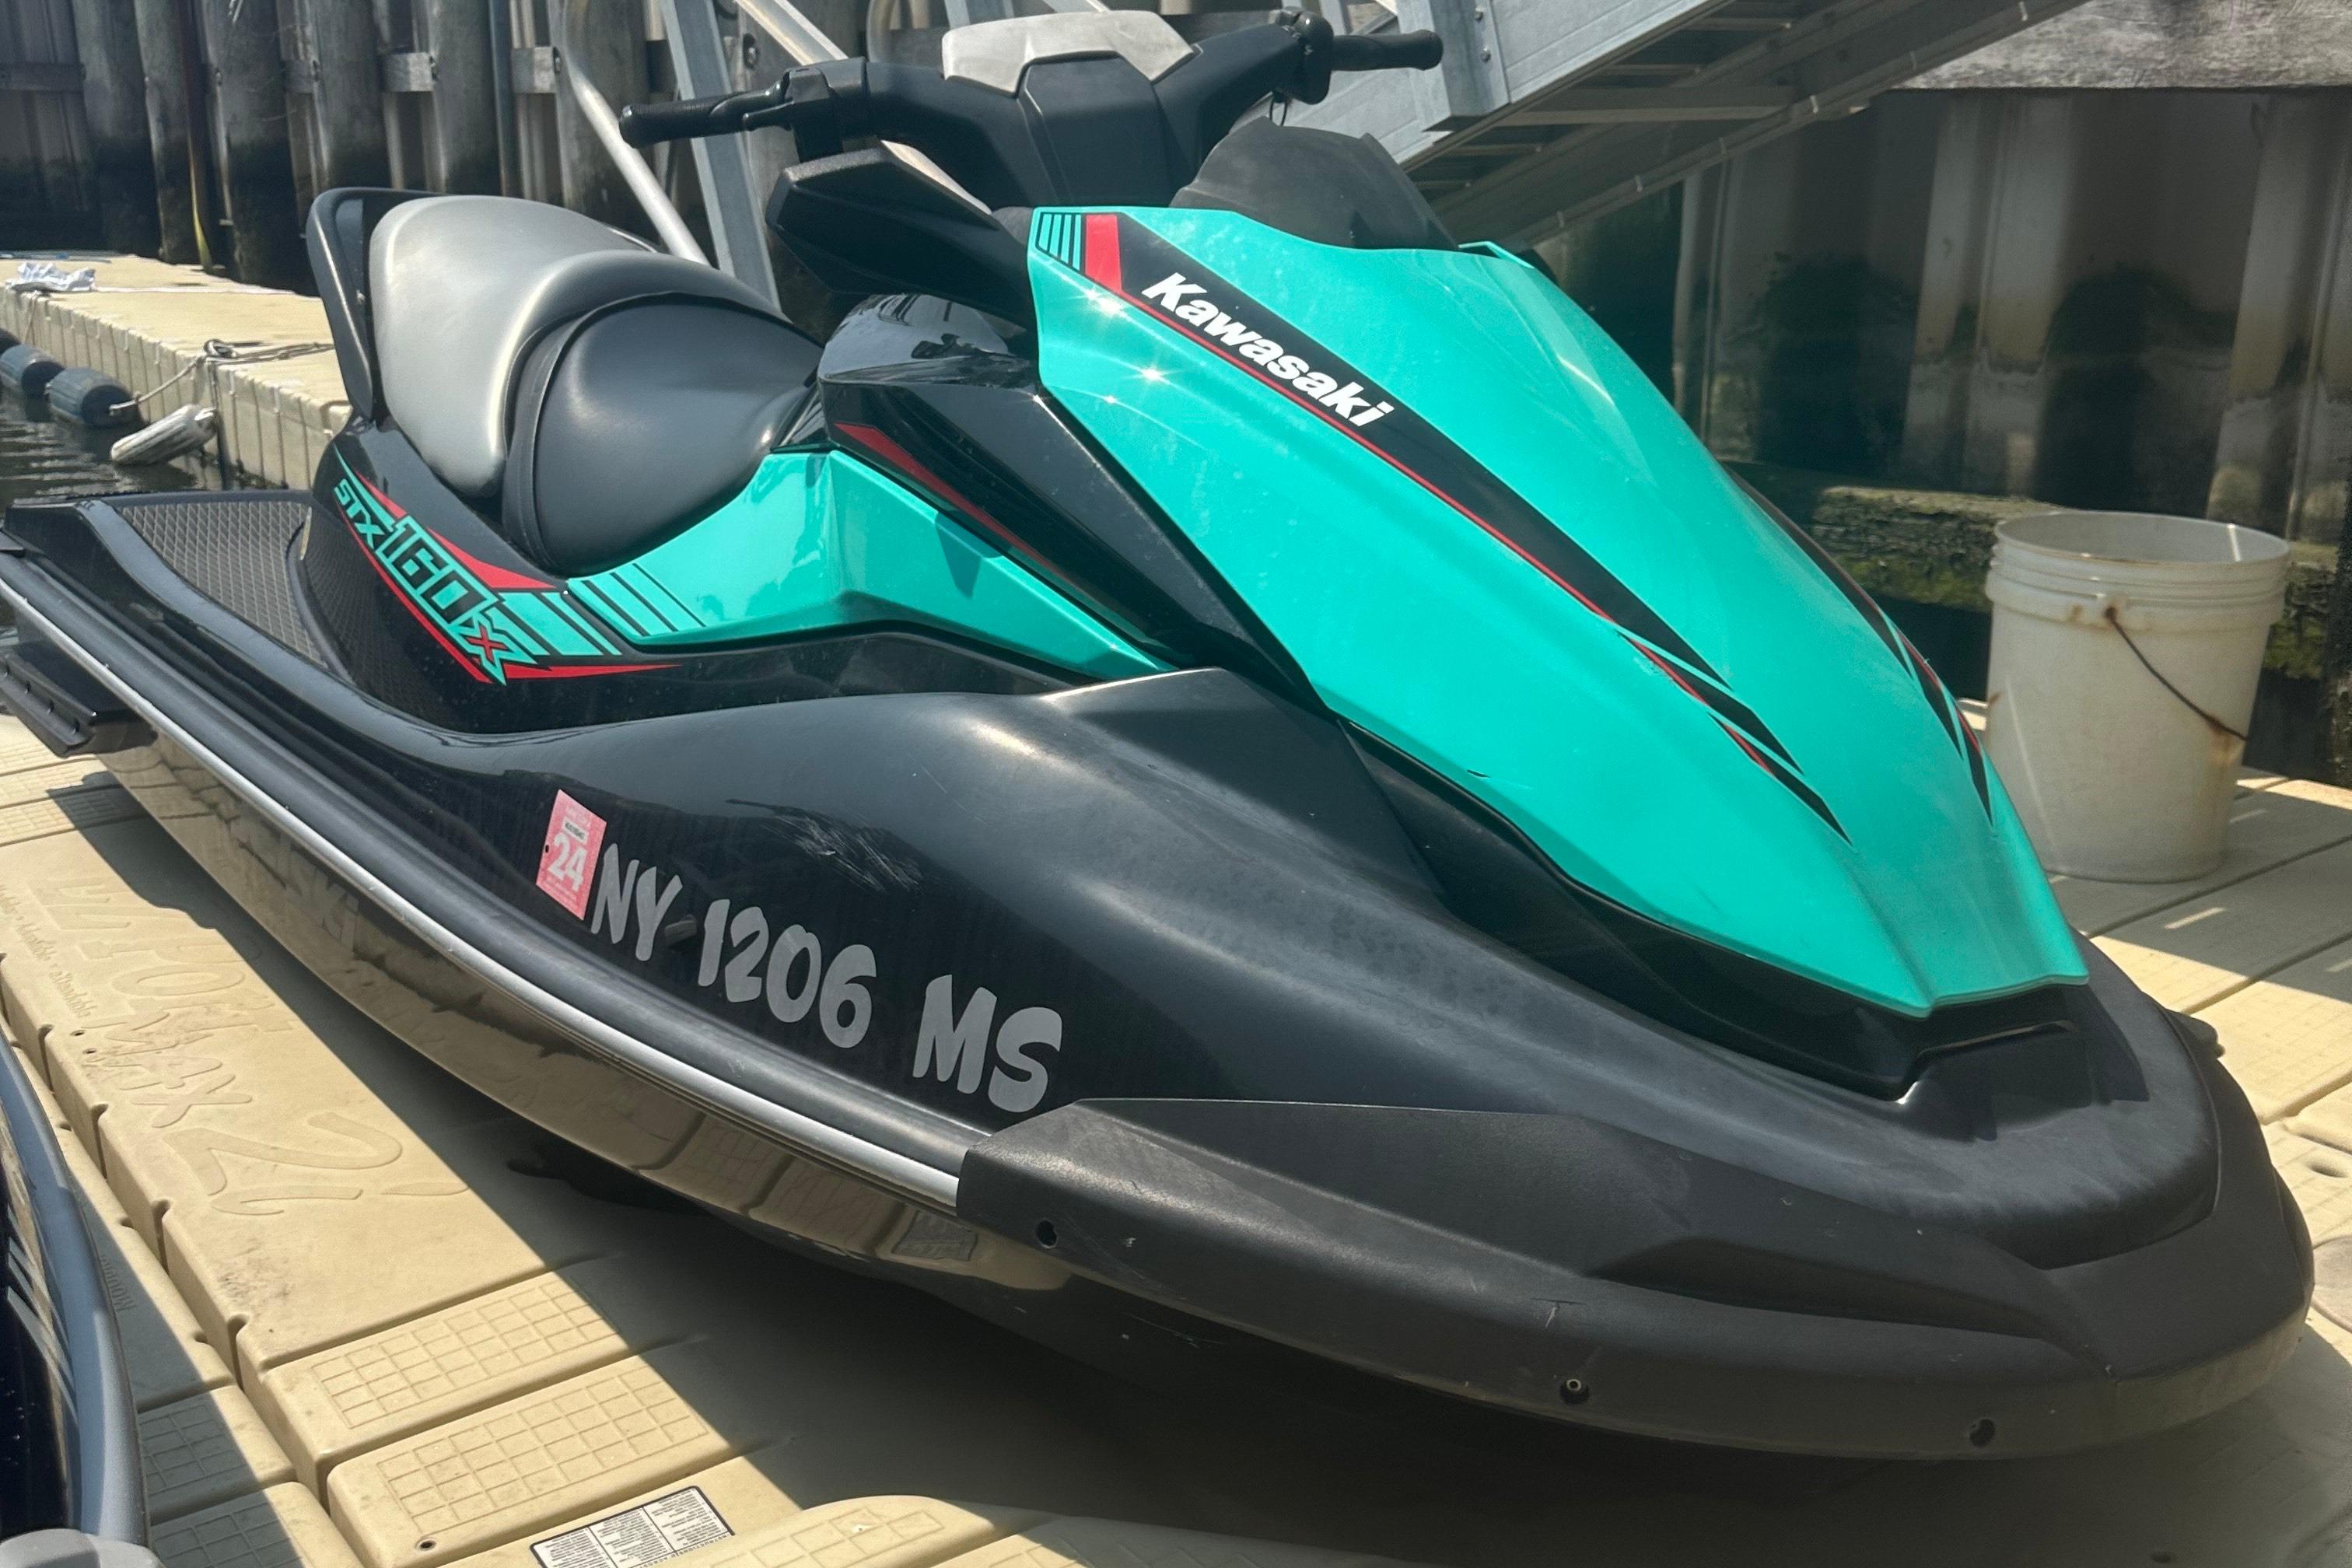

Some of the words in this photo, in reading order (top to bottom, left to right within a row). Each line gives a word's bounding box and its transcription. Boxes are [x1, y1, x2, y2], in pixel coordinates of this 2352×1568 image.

[1141, 272, 1395, 427] Kawasaki
[334, 478, 386, 549] STX
[547, 832, 588, 892] 24
[591, 842, 683, 961] NY
[698, 898, 877, 1048] 1206
[912, 974, 1063, 1113] MS
